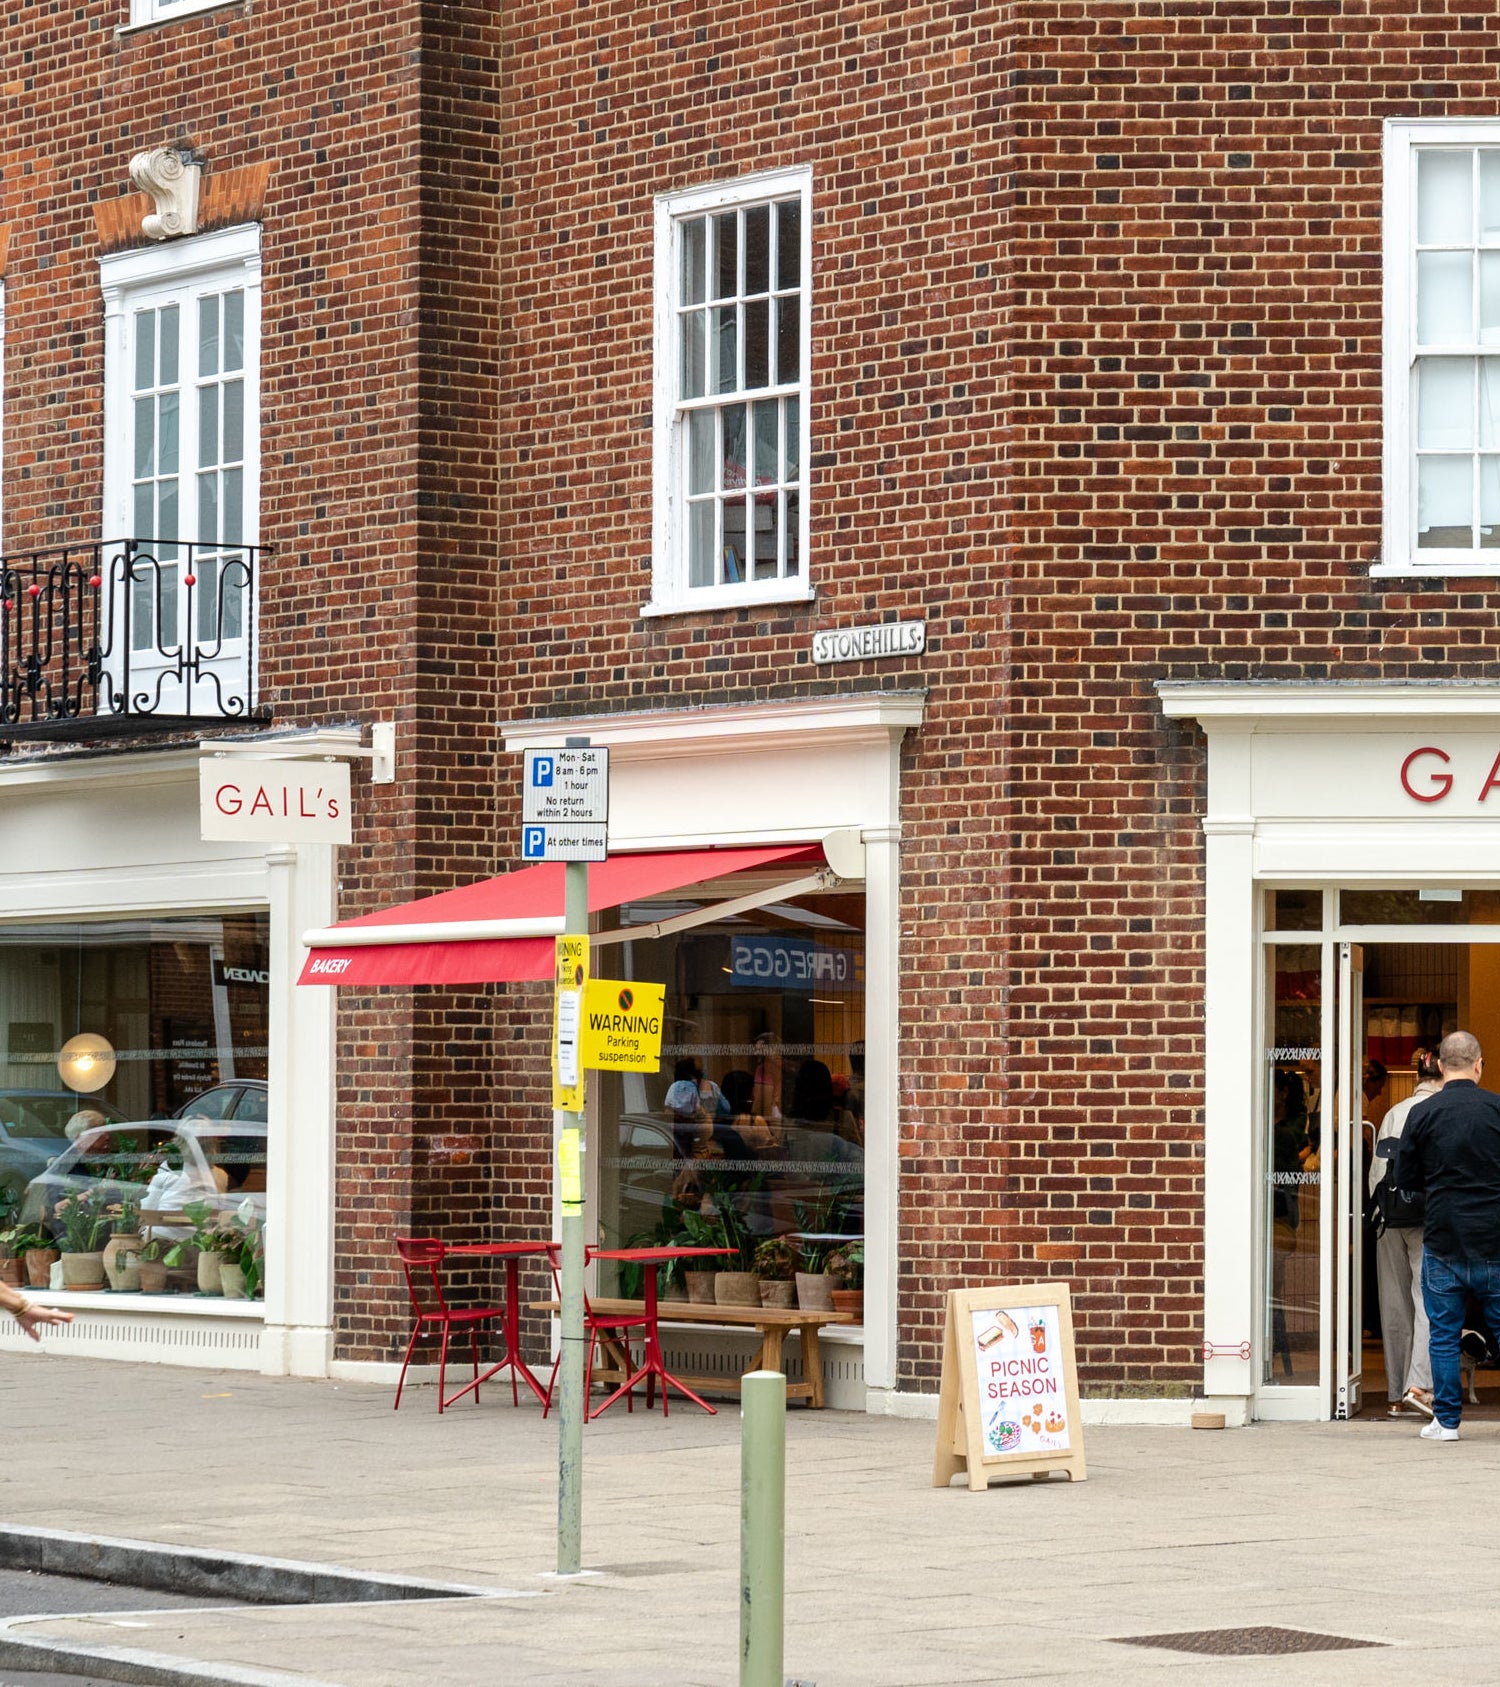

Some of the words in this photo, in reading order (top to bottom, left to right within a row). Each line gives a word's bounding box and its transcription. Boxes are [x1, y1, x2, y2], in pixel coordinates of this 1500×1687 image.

[820, 626, 917, 659] STONEHILLS
[559, 753, 576, 762] Mon
[582, 752, 596, 762] Sat
[555, 766, 561, 775] 8
[579, 766, 585, 775] 6
[586, 768, 598, 776] pm
[570, 781, 588, 789] hour
[215, 784, 339, 819] GAIL's
[546, 796, 557, 805] No
[559, 797, 584, 805] return
[536, 808, 560, 817] within
[562, 808, 569, 817] 2
[570, 808, 593, 817] hours
[547, 837, 557, 846] At
[559, 837, 579, 846] other
[582, 837, 603, 846] times
[309, 958, 353, 974] BAKERY
[589, 1012, 659, 1035] WARNING
[607, 1035, 640, 1051] Parking
[598, 1051, 646, 1063] suspension
[990, 1356, 1049, 1378] PICNIC
[987, 1377, 1058, 1399] SEASON
